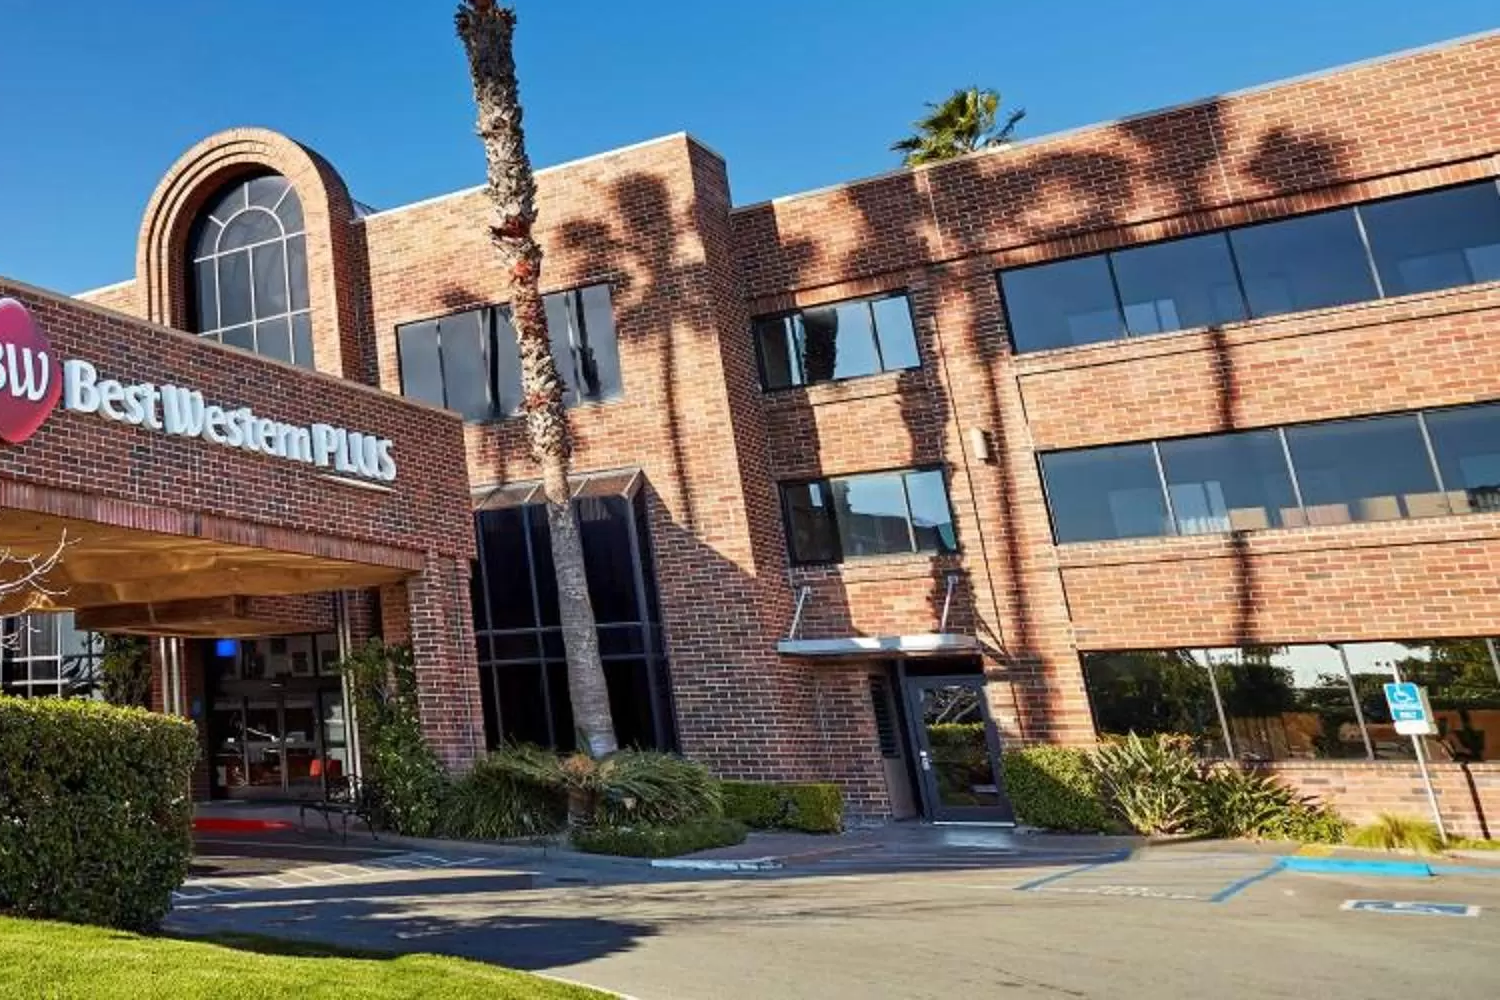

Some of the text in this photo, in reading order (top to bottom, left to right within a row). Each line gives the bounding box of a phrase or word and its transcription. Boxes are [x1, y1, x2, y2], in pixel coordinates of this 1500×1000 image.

[63, 359, 397, 481] Best Western PLUS
